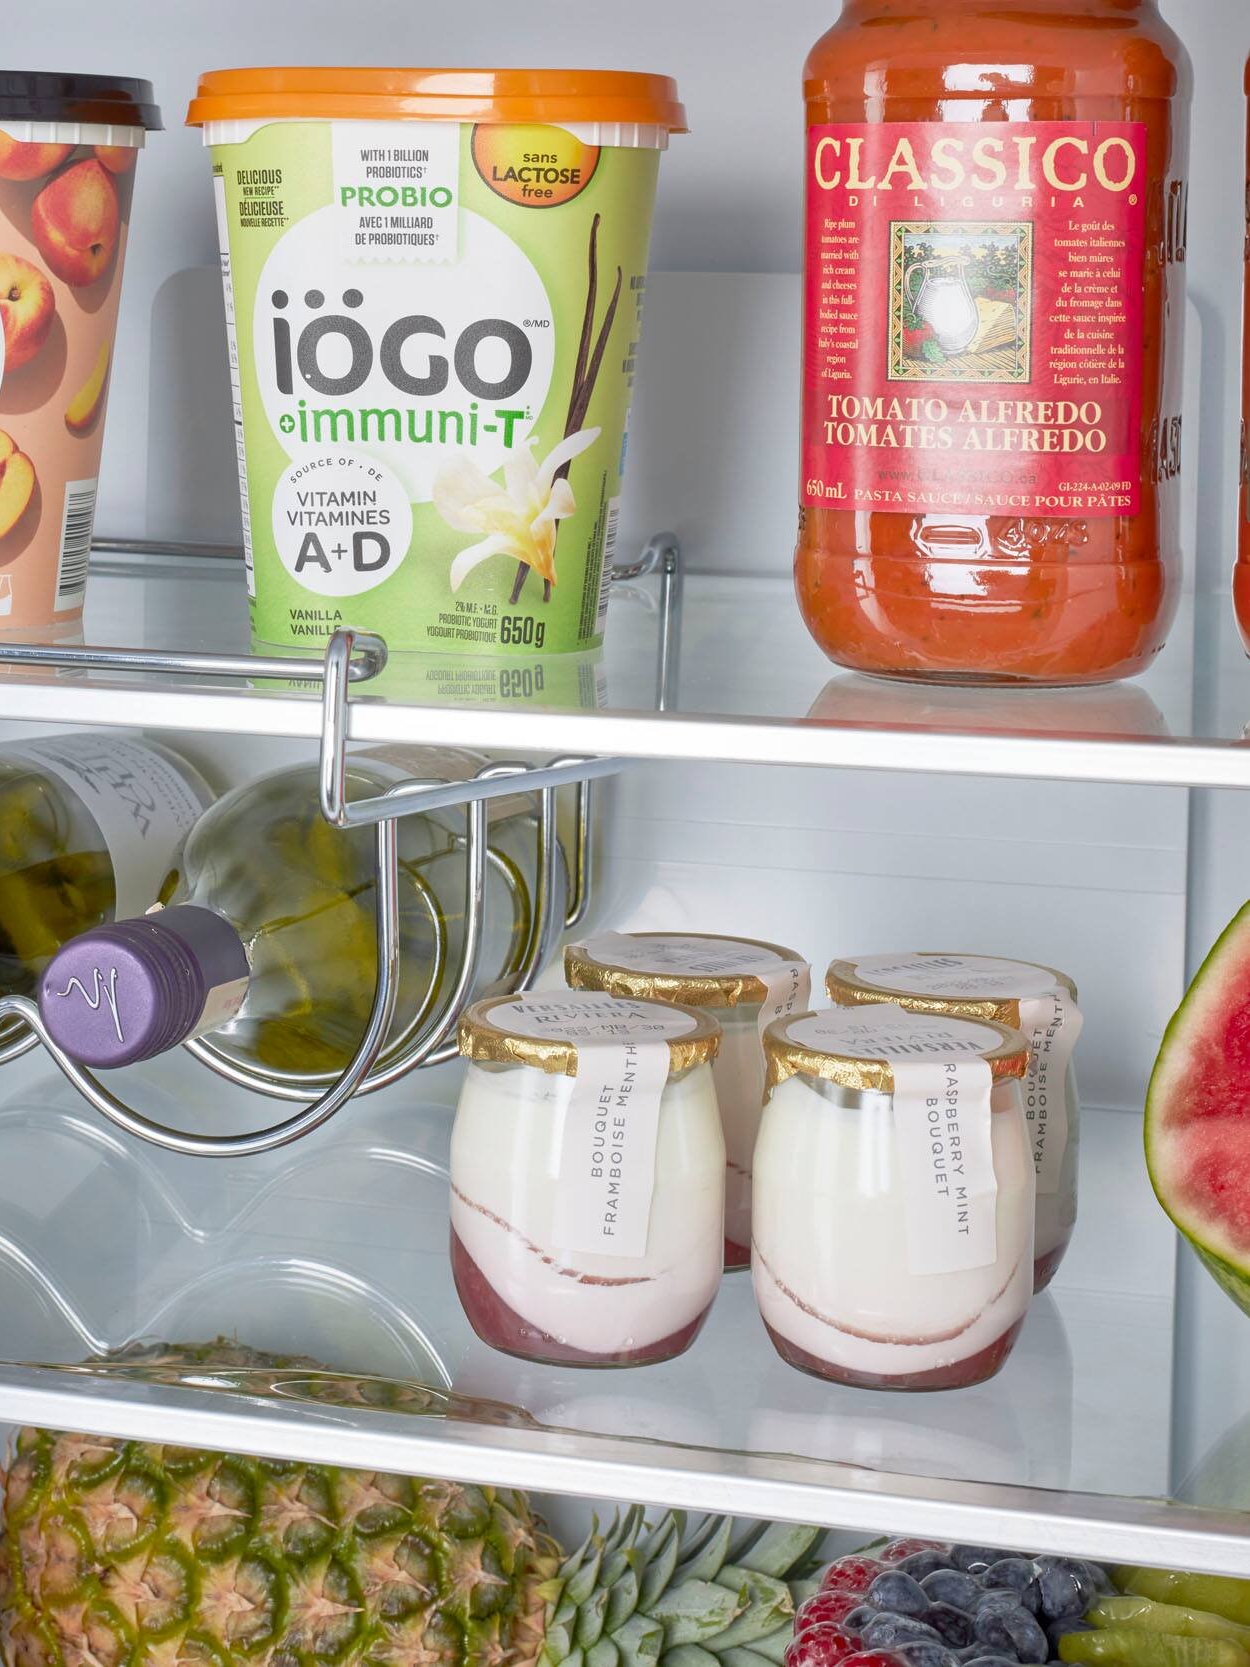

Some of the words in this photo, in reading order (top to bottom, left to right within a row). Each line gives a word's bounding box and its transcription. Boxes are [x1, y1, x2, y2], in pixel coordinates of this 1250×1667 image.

[360, 149, 385, 161] WITH
[394, 149, 429, 161] BILLION
[522, 151, 558, 165] sans
[814, 136, 1136, 191] CLASSICO
[237, 169, 282, 185] DELICIOUS
[492, 165, 581, 185] LACTOSE
[242, 187, 253, 196] NEW
[521, 183, 554, 199] free
[340, 186, 453, 209] PROBIO
[849, 195, 877, 207] DI
[913, 195, 1085, 208] LIGURIA
[239, 199, 284, 216] DÉLICIEUSE
[241, 218, 260, 227] NOUVELLE
[359, 216, 382, 229] AVEC
[391, 216, 433, 229] MILLIARD
[824, 219, 837, 229] Ripe
[838, 219, 856, 229] plum
[1069, 221, 1079, 231] Le
[1081, 221, 1100, 233] goût
[1102, 221, 1115, 231] des
[355, 233, 366, 245] DE
[1054, 239, 1087, 247] tomates
[1090, 237, 1125, 248] italiennes
[844, 250, 859, 260] with
[1068, 252, 1086, 262] bien
[1089, 253, 1114, 263] mûres
[835, 267, 855, 275] cream
[1070, 268, 1094, 278] marie
[1102, 268, 1120, 278] celui
[833, 280, 857, 289] cheeses
[1061, 283, 1072, 293] de
[1084, 284, 1109, 293] crème
[1055, 297, 1067, 307] du
[1070, 297, 1104, 309] fromage
[1105, 297, 1122, 308] dans
[839, 312, 858, 320] sauce
[1049, 313, 1070, 323] cette
[1073, 315, 1096, 323] sauce
[1098, 313, 1126, 324] inspirée
[839, 324, 855, 334] from
[1064, 329, 1074, 339] de
[1087, 329, 1114, 339] cuisine
[835, 339, 858, 349] coastal
[1051, 344, 1105, 354] traditionnelle
[1108, 345, 1117, 354] de
[827, 354, 846, 365] region
[1049, 359, 1076, 371] région
[1108, 359, 1117, 368] de
[828, 369, 852, 379] Liguria.
[1054, 375, 1086, 386] Ligurie,
[1101, 375, 1122, 384] Italie.
[827, 394, 947, 422] TOMATO
[957, 400, 1102, 426] ALFREDO
[823, 420, 952, 450] TOMATES
[965, 428, 1107, 453] ALFREDO
[290, 458, 333, 484] SOURCE
[338, 457, 355, 467] OF
[368, 468, 383, 482] DE
[806, 479, 823, 497] 650
[825, 482, 847, 500] mL
[1058, 481, 1121, 492] GI-224-A-02-09
[297, 490, 377, 507] VITAMIN
[854, 488, 903, 503] PASTA
[906, 491, 963, 505] SAUCE
[974, 493, 1031, 507] SAUCE
[1034, 495, 1083, 508] POUR
[1087, 492, 1132, 507] PÂTES
[287, 510, 391, 526] VITAMINES
[290, 609, 342, 620] VANILLA
[439, 613, 471, 627] PROBIOTIC
[472, 616, 497, 629] YOGURT
[426, 626, 455, 638] YOGOURT
[456, 629, 496, 643] PROBIOTIQUE
[501, 616, 534, 645] 650
[535, 622, 545, 648] g
[512, 1002, 641, 1014] VERSAILLES
[535, 1011, 647, 1024] RIVIERA
[591, 1084, 614, 1178] BOUQUET
[926, 1098, 949, 1196] BOUQUET
[943, 1063, 965, 1176] RASPBERRY
[955, 1186, 969, 1235] MINT
[603, 1117, 625, 1236] FRAMBOISE
